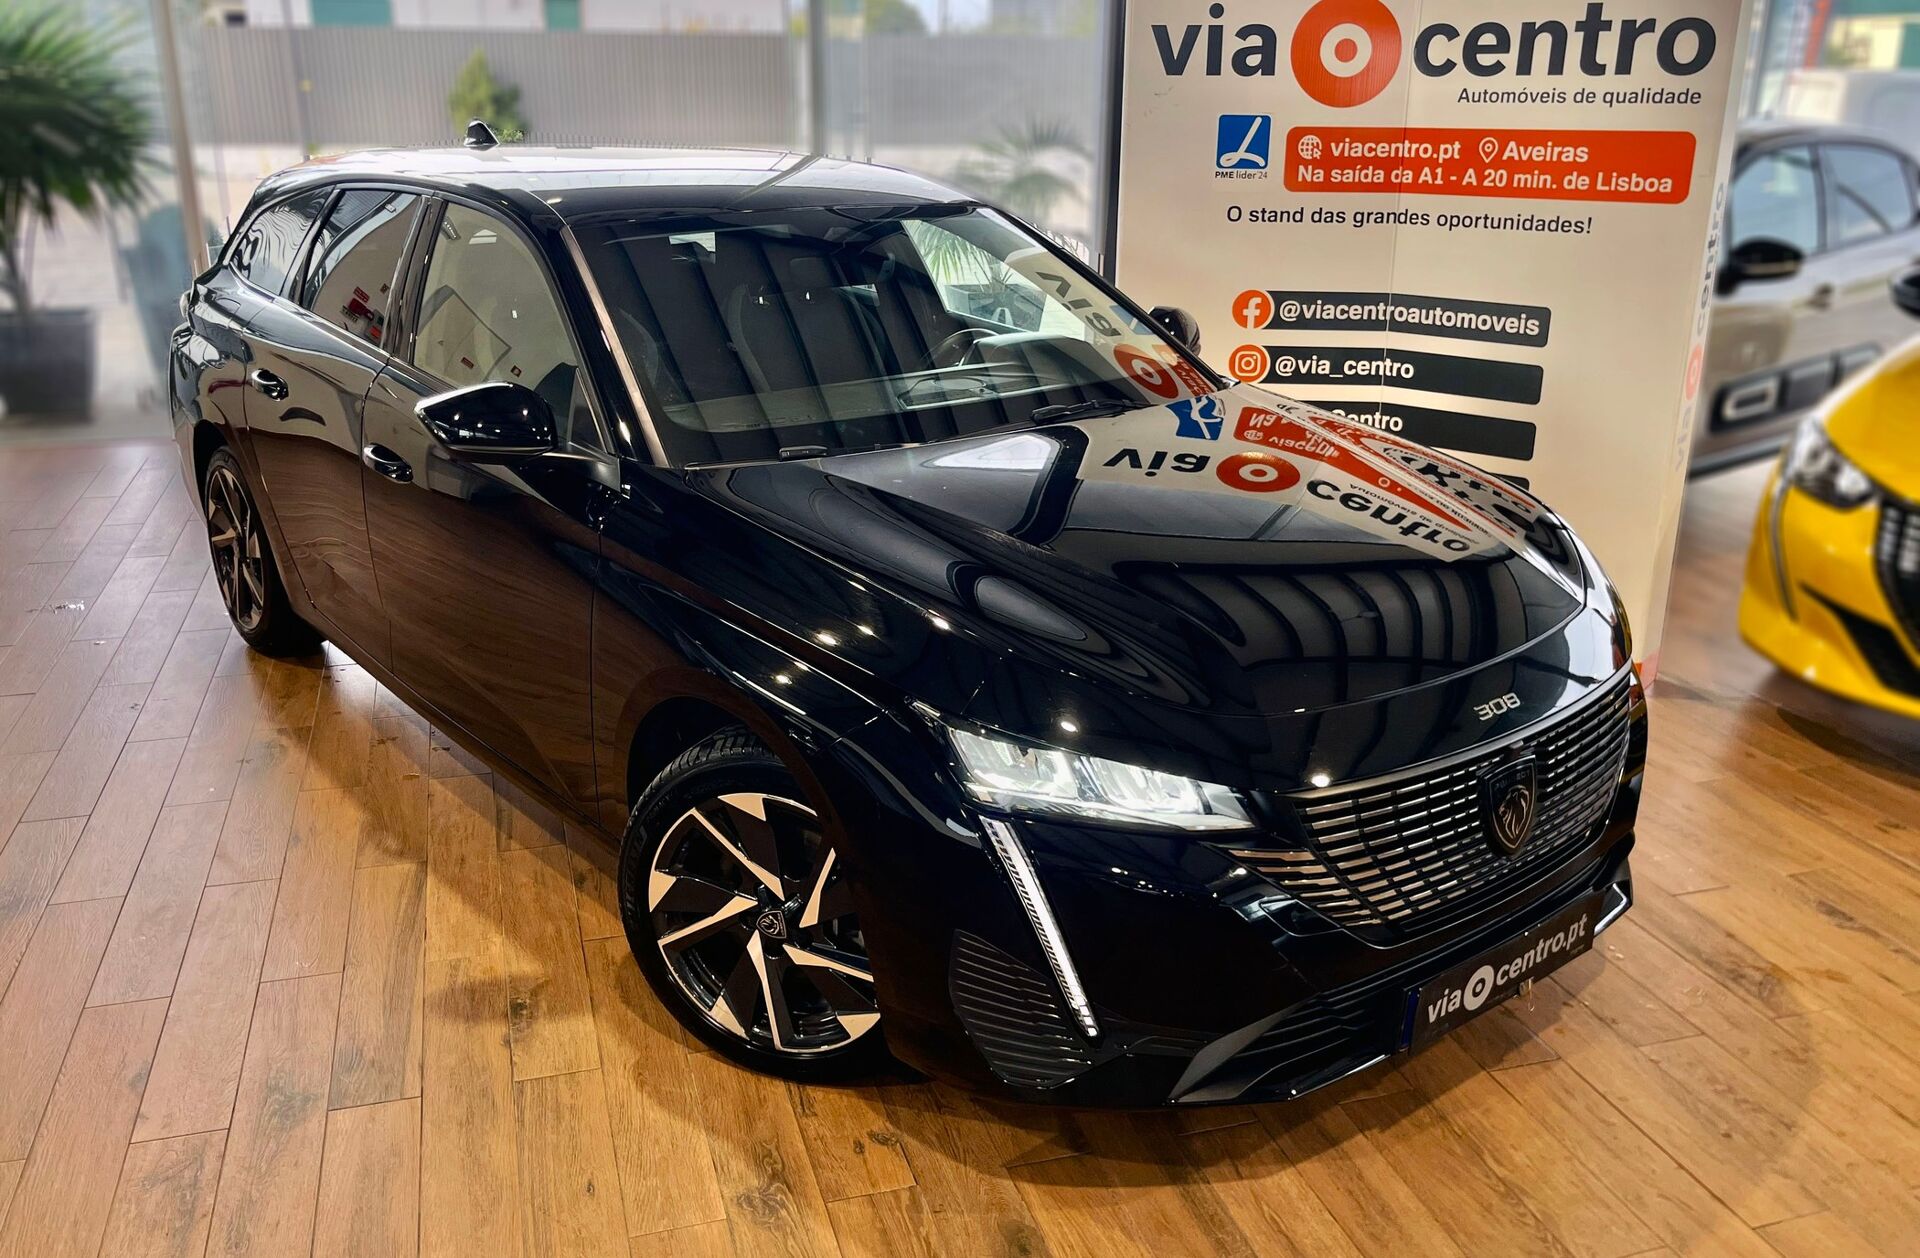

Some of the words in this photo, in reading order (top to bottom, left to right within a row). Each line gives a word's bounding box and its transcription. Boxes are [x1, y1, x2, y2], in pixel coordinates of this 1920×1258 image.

[1151, 3, 1277, 77] via
[1413, 2, 1717, 77] centro
[1457, 87, 1567, 104] Automóveis
[1573, 87, 1596, 104] de
[1602, 87, 1702, 108] qualidade
[1330, 138, 1461, 163] viacentro.pt
[1502, 141, 1589, 162] Aveiras
[1215, 171, 1234, 179] PME
[1297, 165, 1325, 182] Na
[1330, 165, 1384, 183] saída
[1391, 166, 1413, 184] da
[1418, 167, 1444, 184] A1
[1462, 168, 1477, 186] A
[1483, 169, 1507, 187] 20
[1513, 170, 1557, 189] min.
[1563, 172, 1590, 190] de
[1597, 172, 1672, 193] Lisboa
[1227, 206, 1242, 222] O
[1249, 206, 1304, 223] stand
[1311, 207, 1346, 224] das
[1353, 208, 1430, 228] grandes
[1437, 213, 1593, 234] oportunidades!
[1279, 300, 1540, 336] @viacentroautomoveis
[1275, 355, 1414, 379] @via_centro
[1473, 692, 1521, 720] 308
[1427, 988, 1462, 1024] via
[1496, 913, 1588, 986] centro.pt
